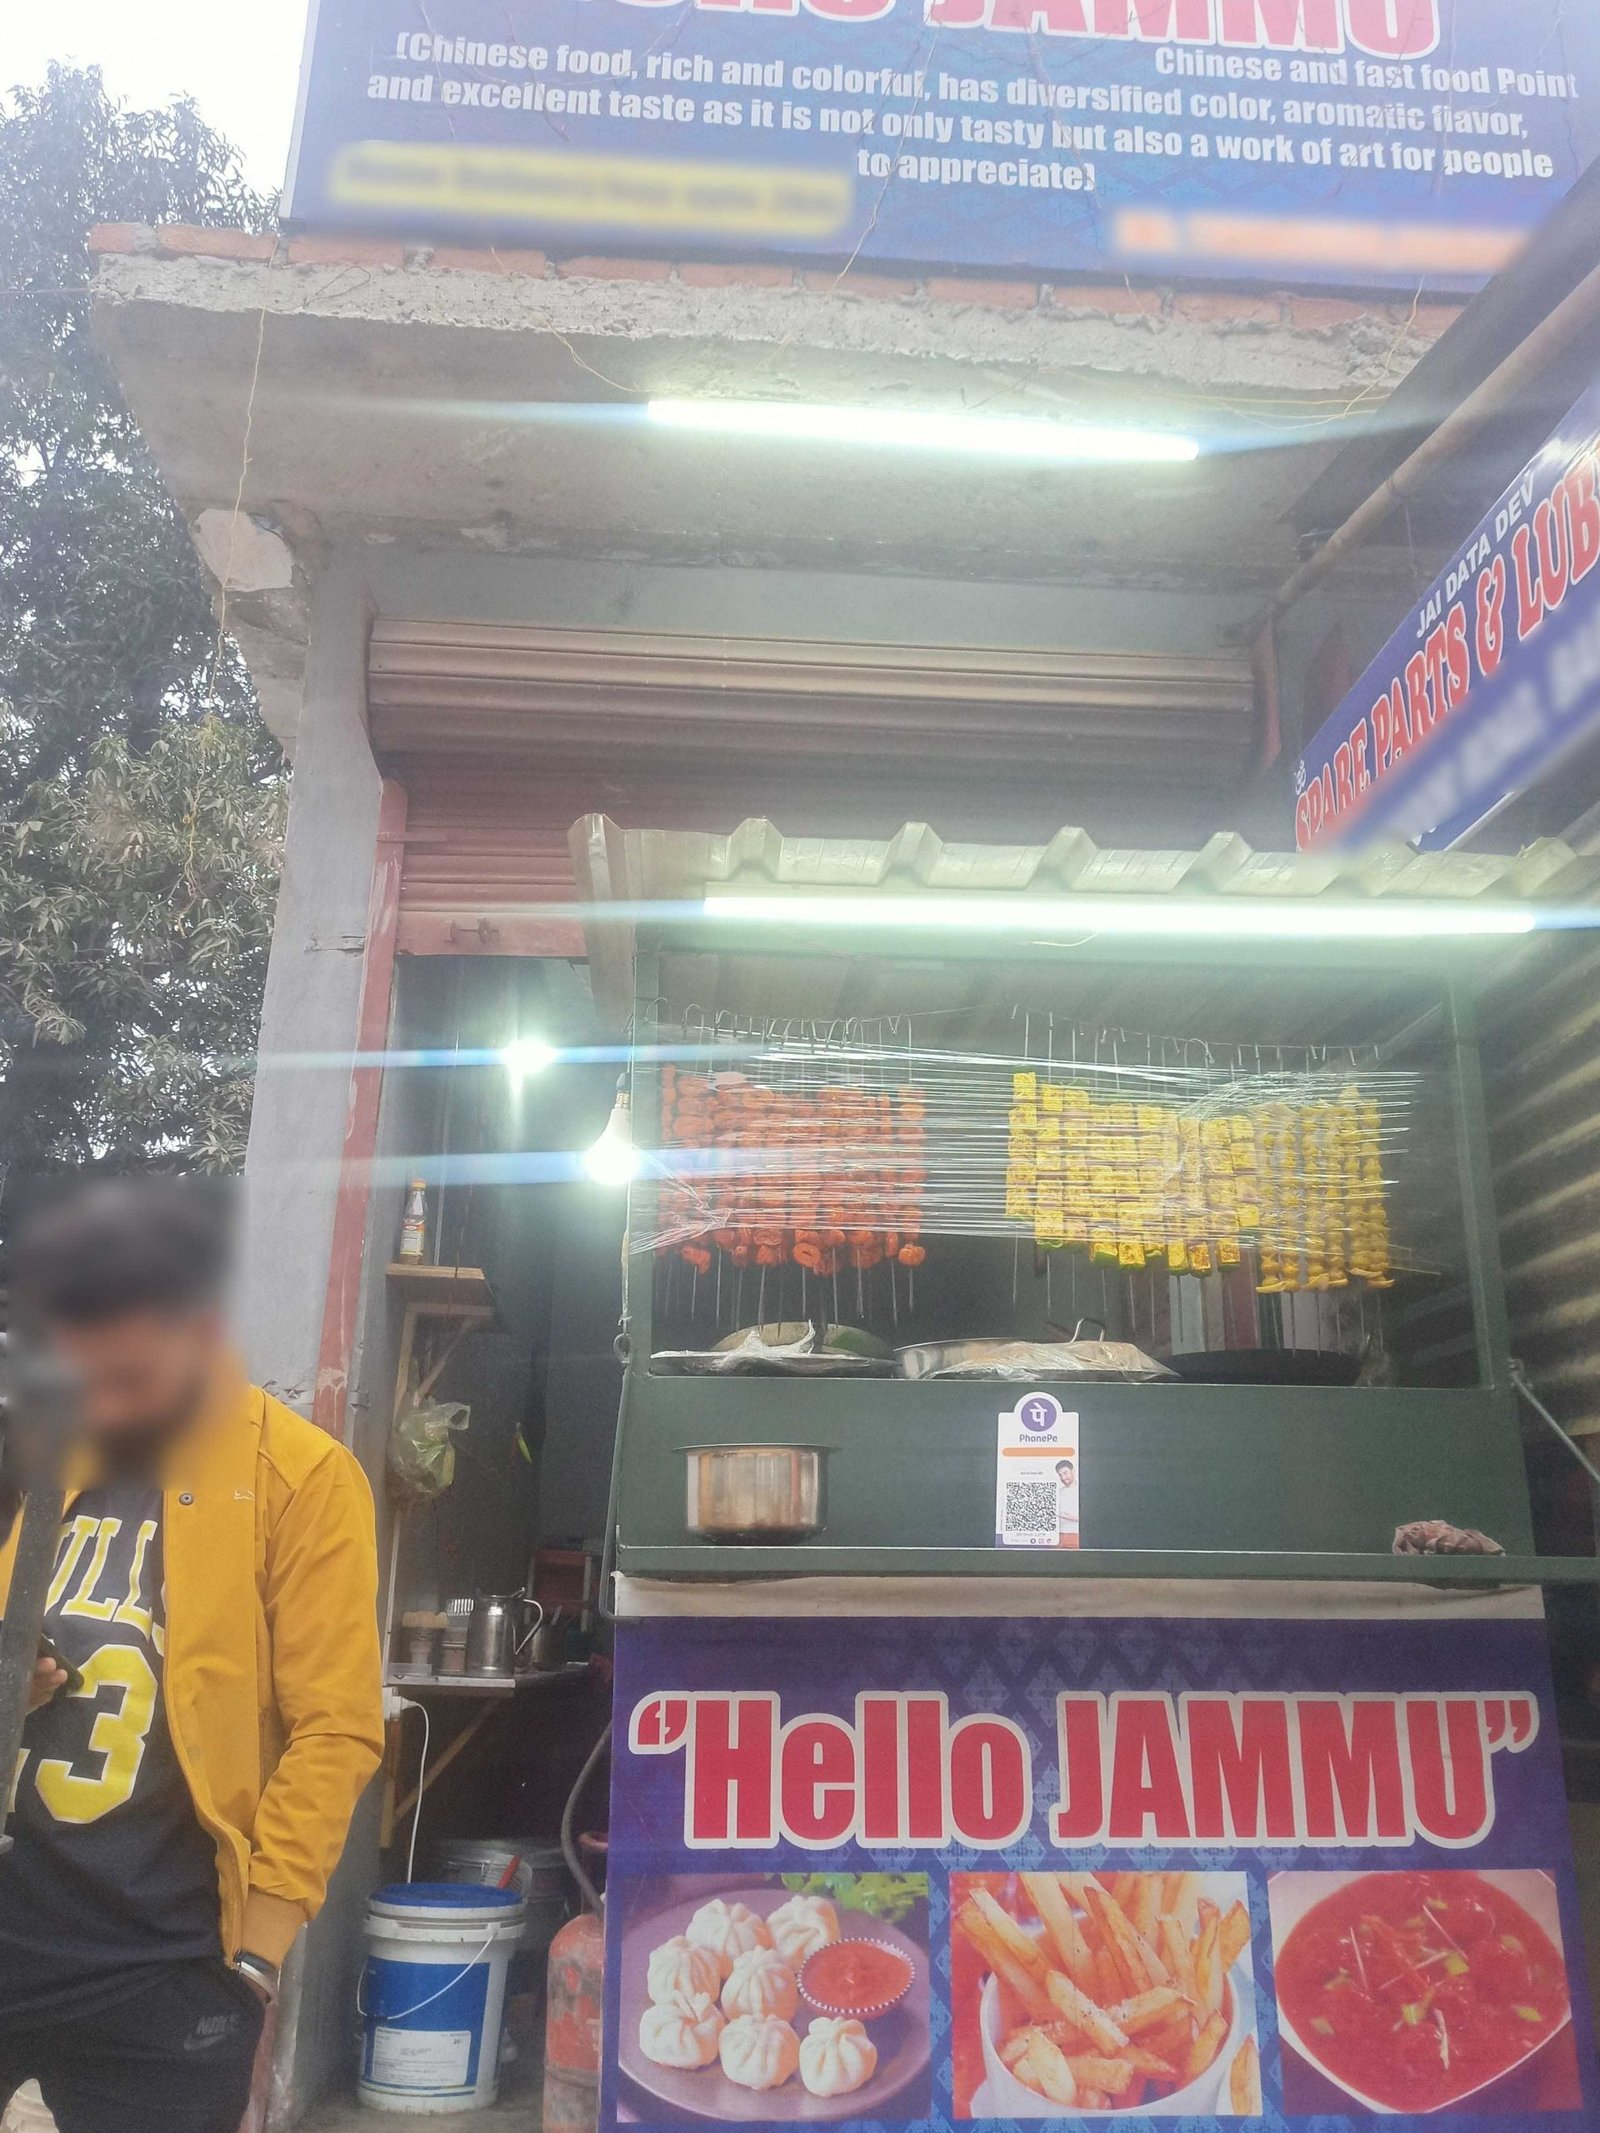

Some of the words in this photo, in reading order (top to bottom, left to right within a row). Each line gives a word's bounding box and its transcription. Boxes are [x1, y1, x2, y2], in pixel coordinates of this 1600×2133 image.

[556, 44, 638, 80] food,
[646, 51, 714, 83] rich
[721, 60, 784, 88] and
[792, 64, 931, 101] colorful,
[938, 72, 999, 103] has
[1006, 77, 1182, 116] diversified
[1190, 92, 1276, 125] color,
[1283, 99, 1425, 131] aromatic
[1155, 47, 1282, 81] Chinese
[1289, 59, 1348, 86] and
[1354, 60, 1415, 89] fast
[1420, 63, 1490, 94] food
[1497, 67, 1579, 98] Point
[367, 74, 433, 103] and
[442, 80, 601, 115] excellent
[608, 90, 695, 121] taste
[703, 99, 743, 125] as
[750, 99, 774, 128] it
[781, 101, 812, 131] is
[820, 108, 875, 135] not
[881, 111, 953, 143] only
[960, 114, 1045, 149] tasty
[1052, 120, 1107, 151] but
[1113, 125, 1182, 156] also
[1190, 133, 1209, 158] a
[1215, 134, 1295, 163] work
[1301, 137, 1332, 165] of
[1339, 141, 1386, 168] art
[1391, 142, 1436, 171] for
[1443, 148, 1554, 178] people
[857, 149, 891, 177] to
[1416, 589, 1441, 638] JAI
[1445, 532, 1491, 603] DATA
[1494, 469, 1535, 543] DEV
[1371, 600, 1470, 779] PARTS
[1476, 553, 1506, 677] &
[1511, 446, 1600, 641] LUB
[1019, 1434, 1058, 1443] PhonePe
[8, 1644, 158, 1824] 3
